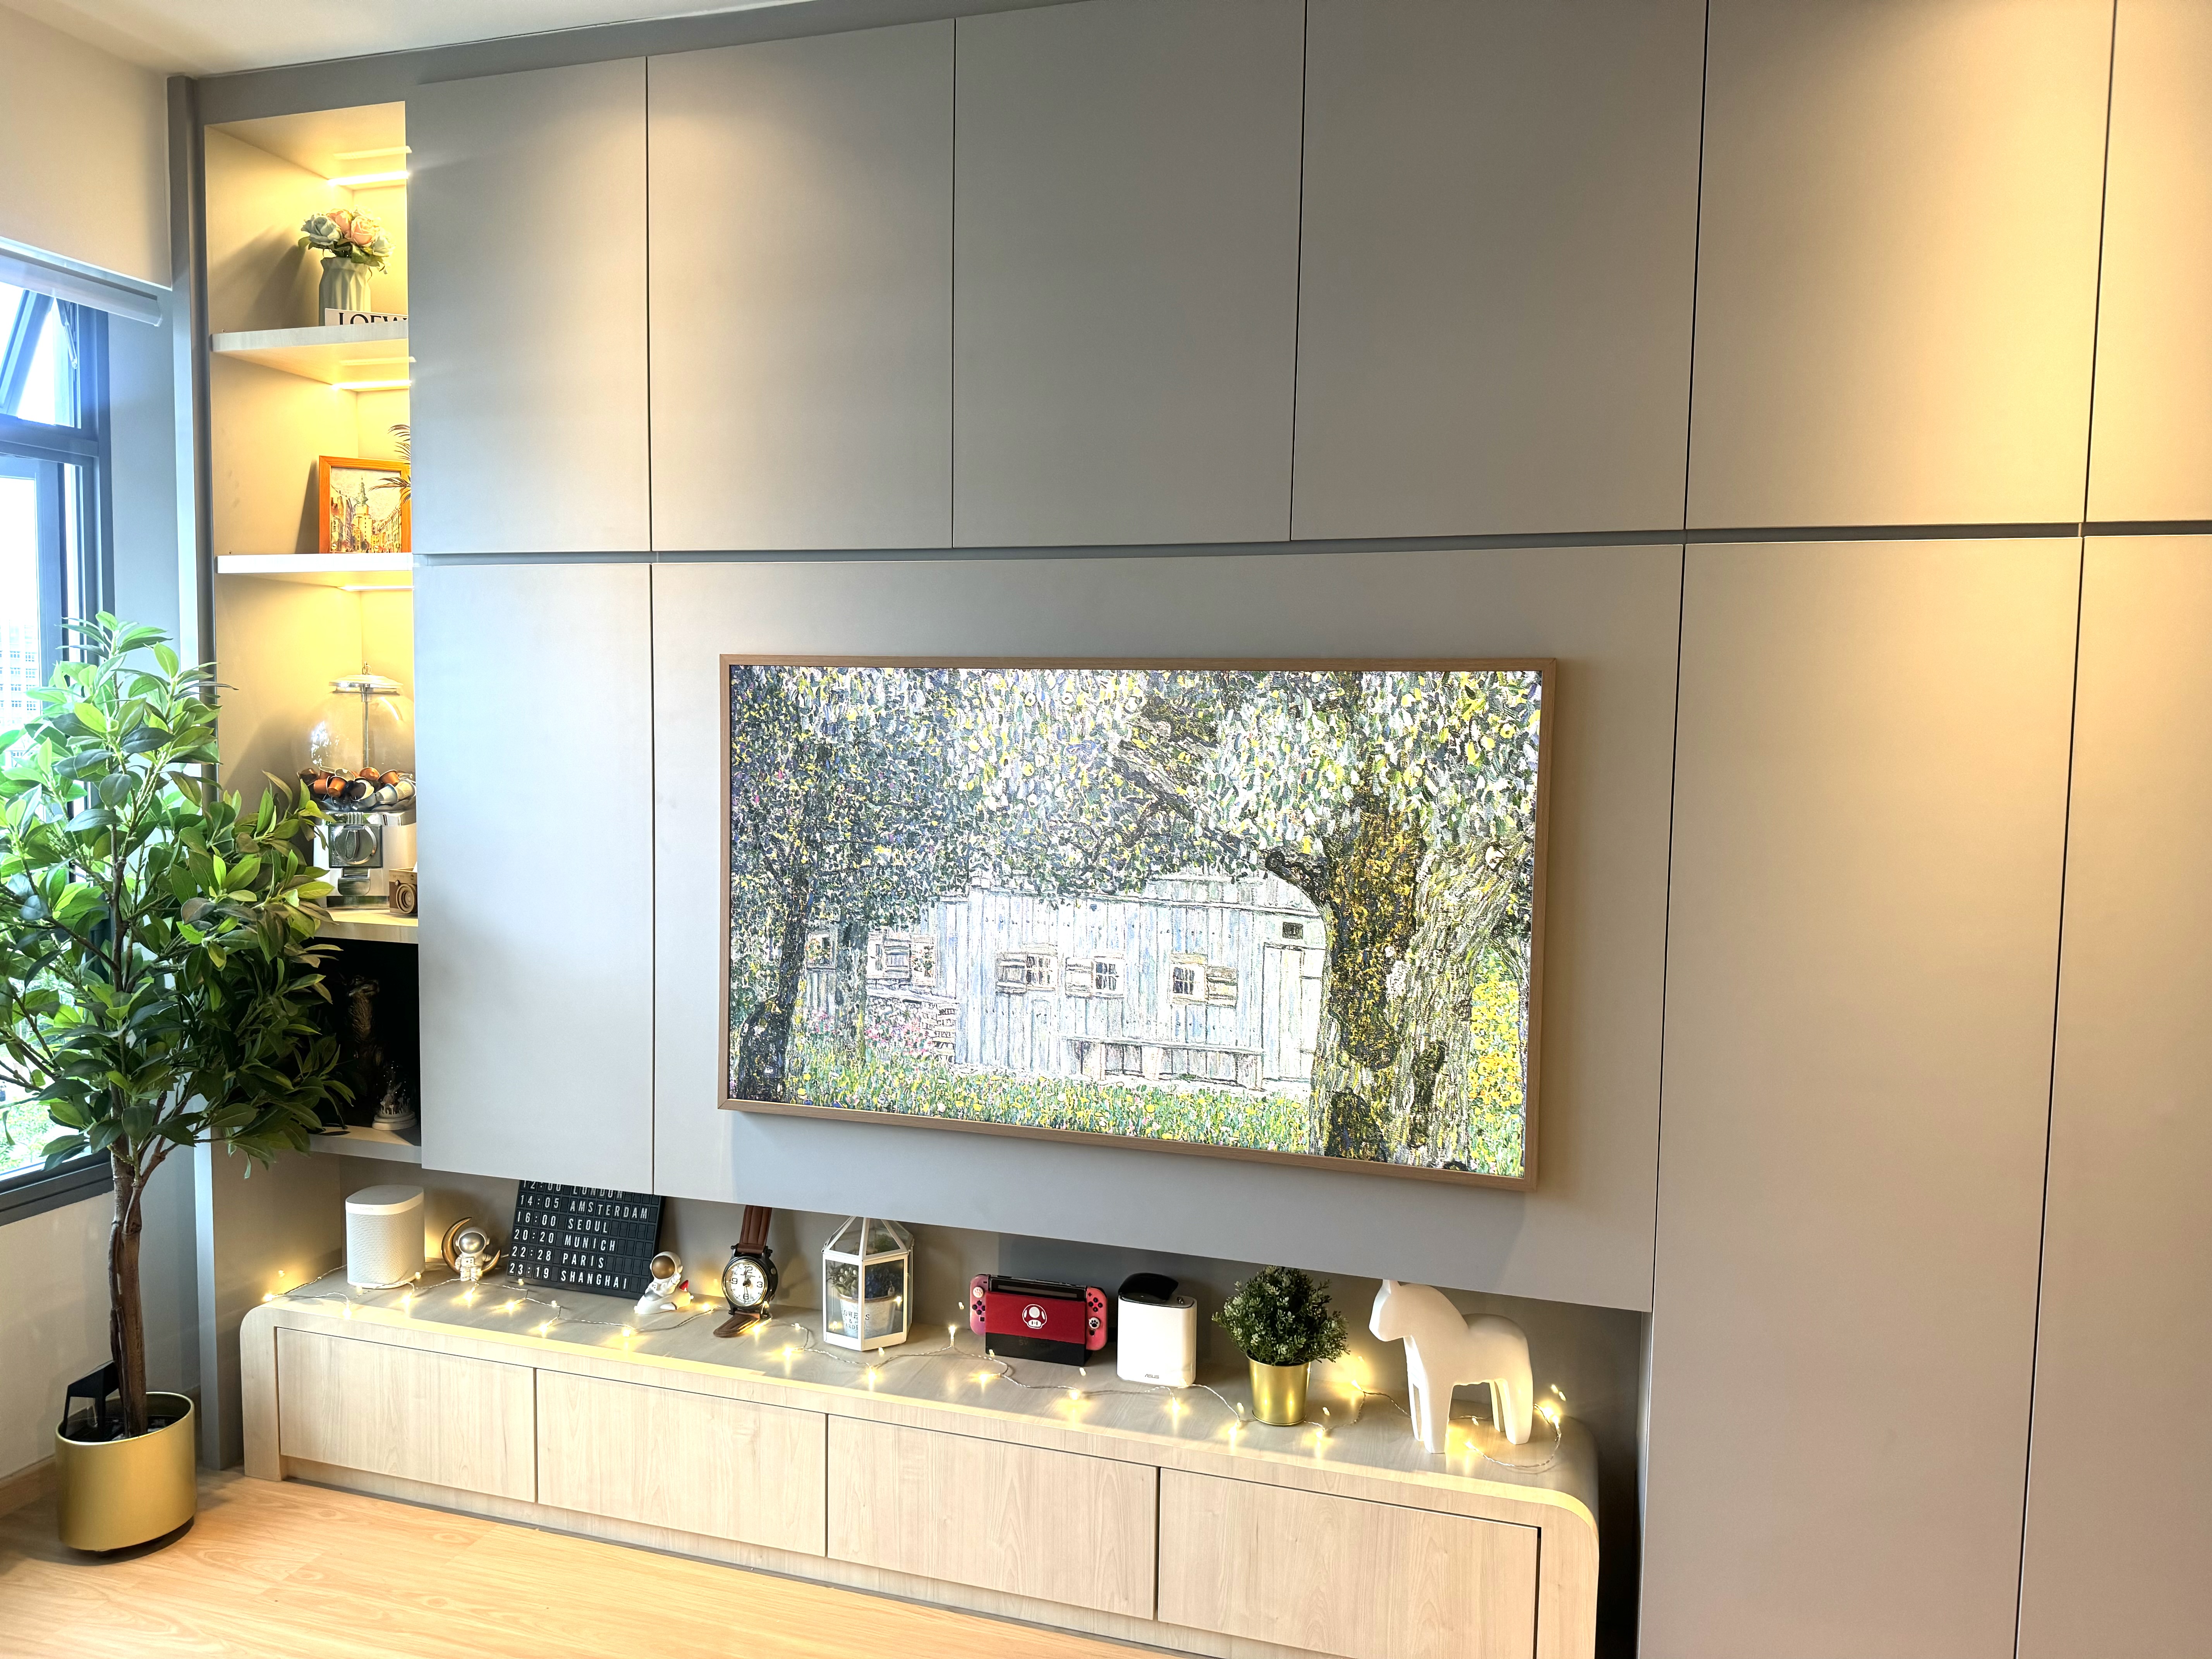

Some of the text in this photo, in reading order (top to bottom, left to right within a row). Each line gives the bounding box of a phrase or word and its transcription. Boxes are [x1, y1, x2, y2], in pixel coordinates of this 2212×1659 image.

[523, 1180, 623, 1199] 12:00 LONDON
[521, 1195, 648, 1219] 14:05 AMSTERDAM
[568, 1218, 607, 1233] SEOUL
[514, 1229, 615, 1251] 20:20 MUNICH
[512, 1246, 604, 1268] 22:28 PARIS
[509, 1262, 627, 1289] 23:19 SHANGHAI
[744, 1266, 753, 1274] 12
